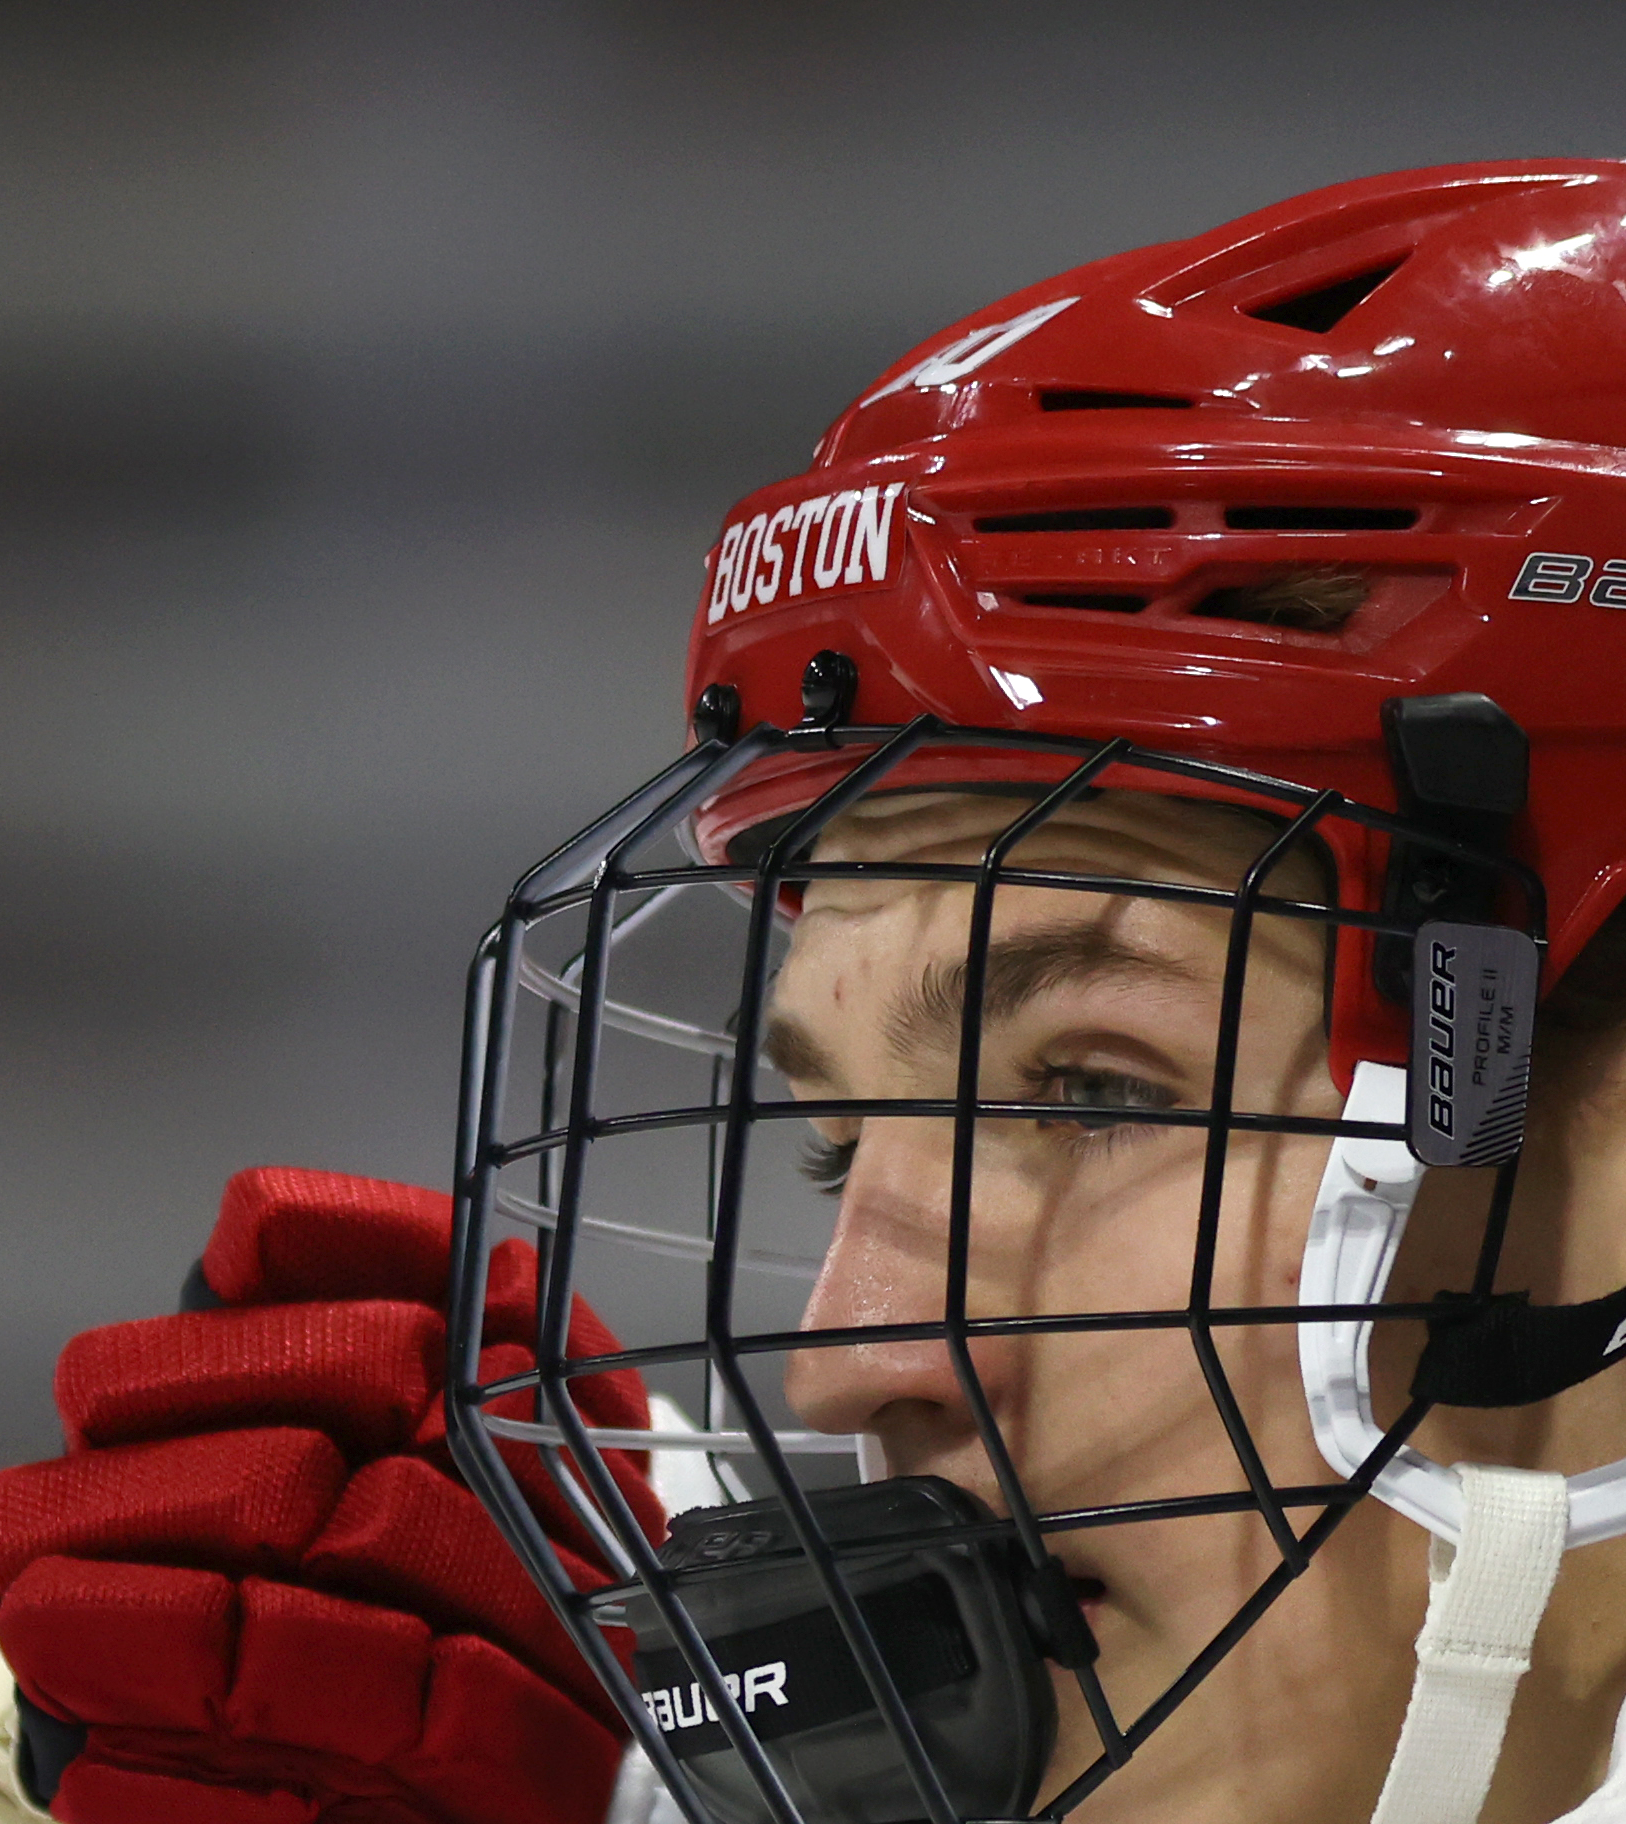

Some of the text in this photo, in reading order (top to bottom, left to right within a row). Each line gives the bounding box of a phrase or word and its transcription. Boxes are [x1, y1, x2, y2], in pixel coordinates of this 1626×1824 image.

[707, 481, 906, 626] BOSTON
[1429, 941, 1457, 1140] BAUER
[1472, 986, 1496, 1087] PROFILE
[1497, 1005, 1515, 1055] M/M
